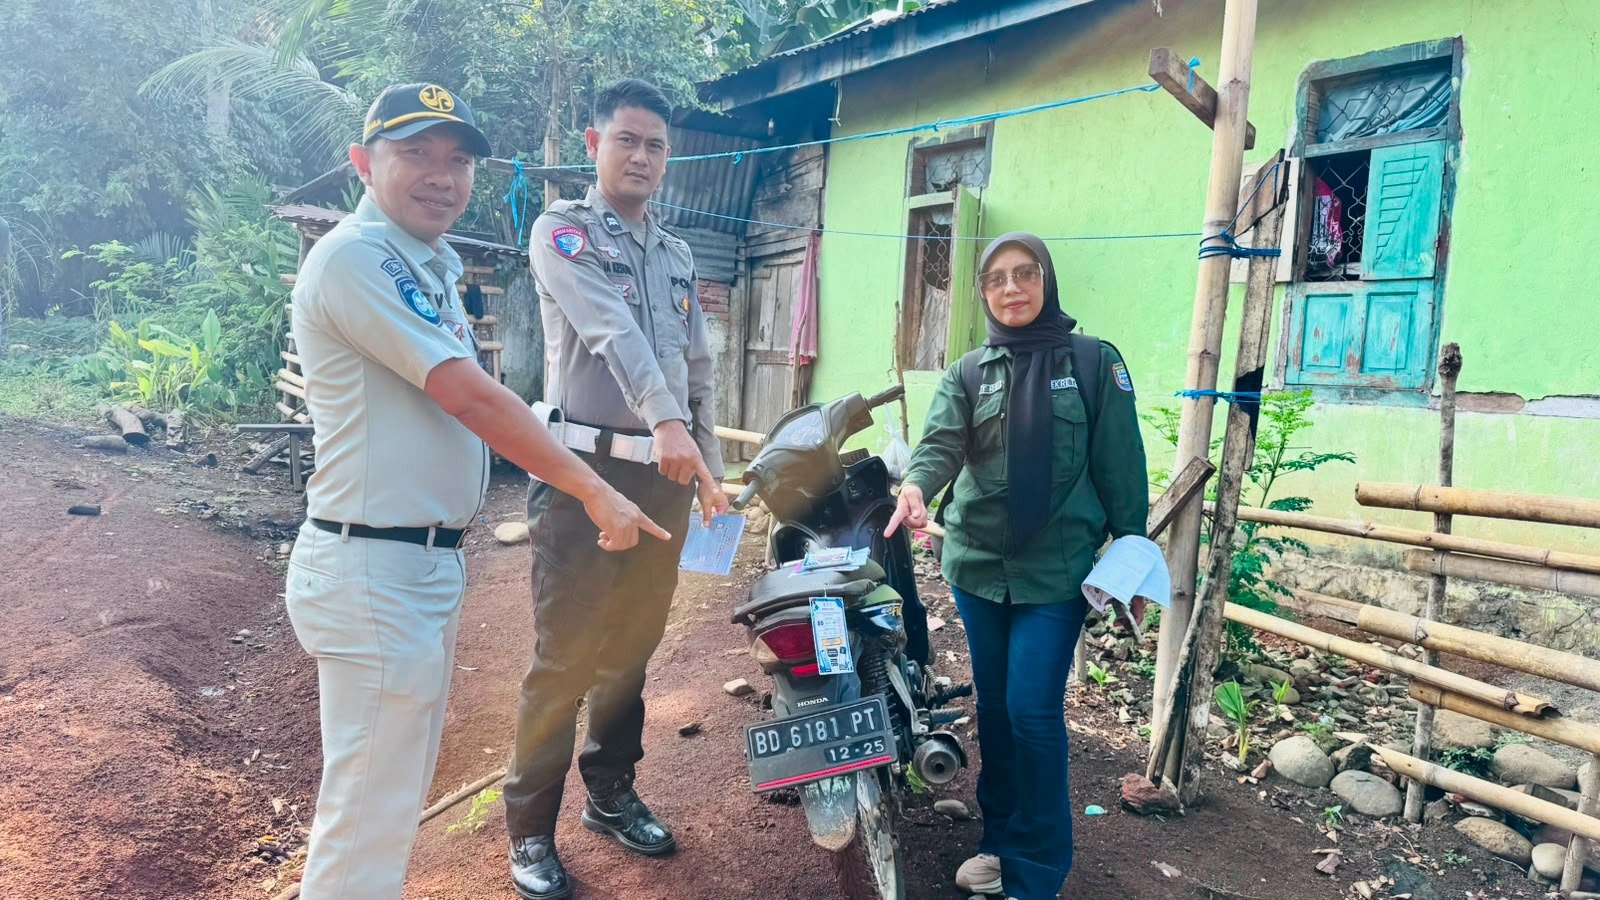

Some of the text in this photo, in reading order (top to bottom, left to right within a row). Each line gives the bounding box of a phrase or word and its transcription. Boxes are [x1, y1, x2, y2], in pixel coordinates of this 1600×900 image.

[797, 697, 829, 708] HONDA
[754, 707, 875, 755] BD 6181 PT
